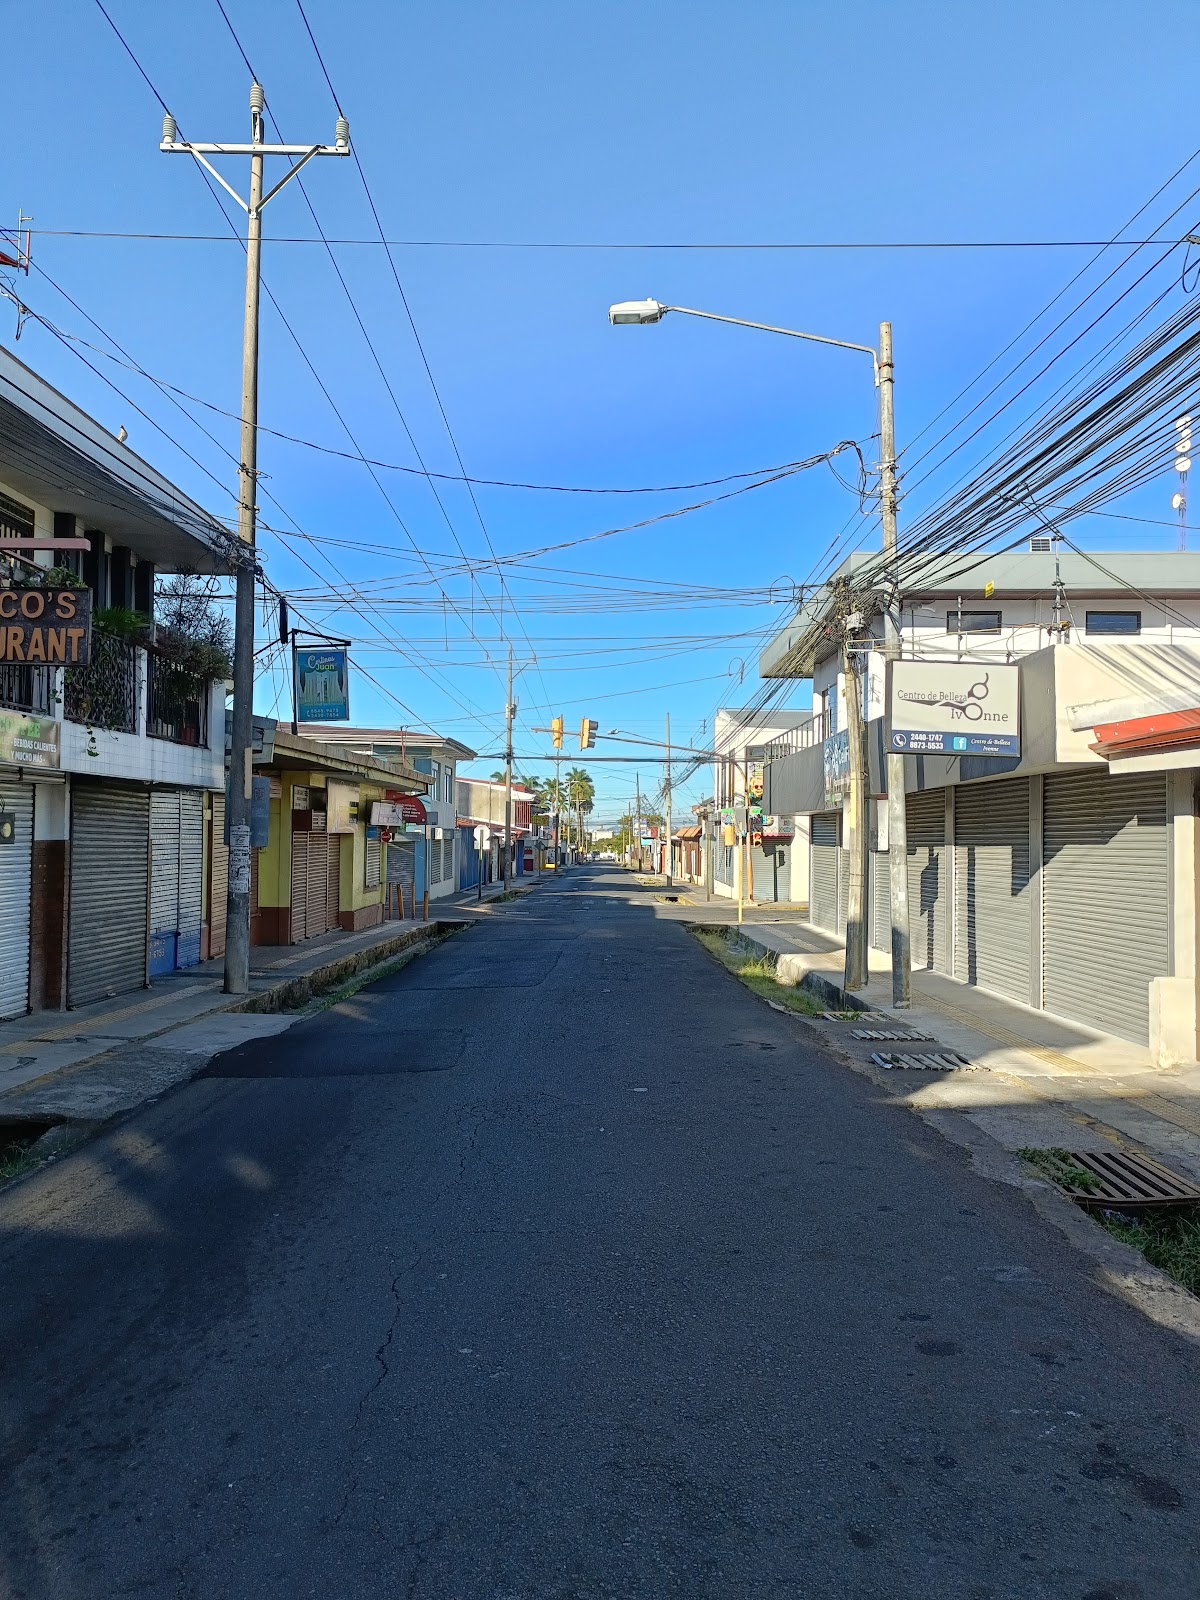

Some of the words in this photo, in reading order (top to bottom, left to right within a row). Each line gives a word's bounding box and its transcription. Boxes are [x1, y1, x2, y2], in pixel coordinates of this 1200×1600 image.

[897, 690, 926, 700] Centro
[927, 691, 937, 700] de
[939, 691, 968, 701] Belleza
[910, 733, 943, 742] 2440-1747
[13, 738, 34, 750] BEBIDAS
[34, 740, 57, 753] CALIENTES
[909, 741, 944, 750] 8873-5533
[15, 751, 32, 762] MUCHO
[32, 752, 43, 763] MÁS
